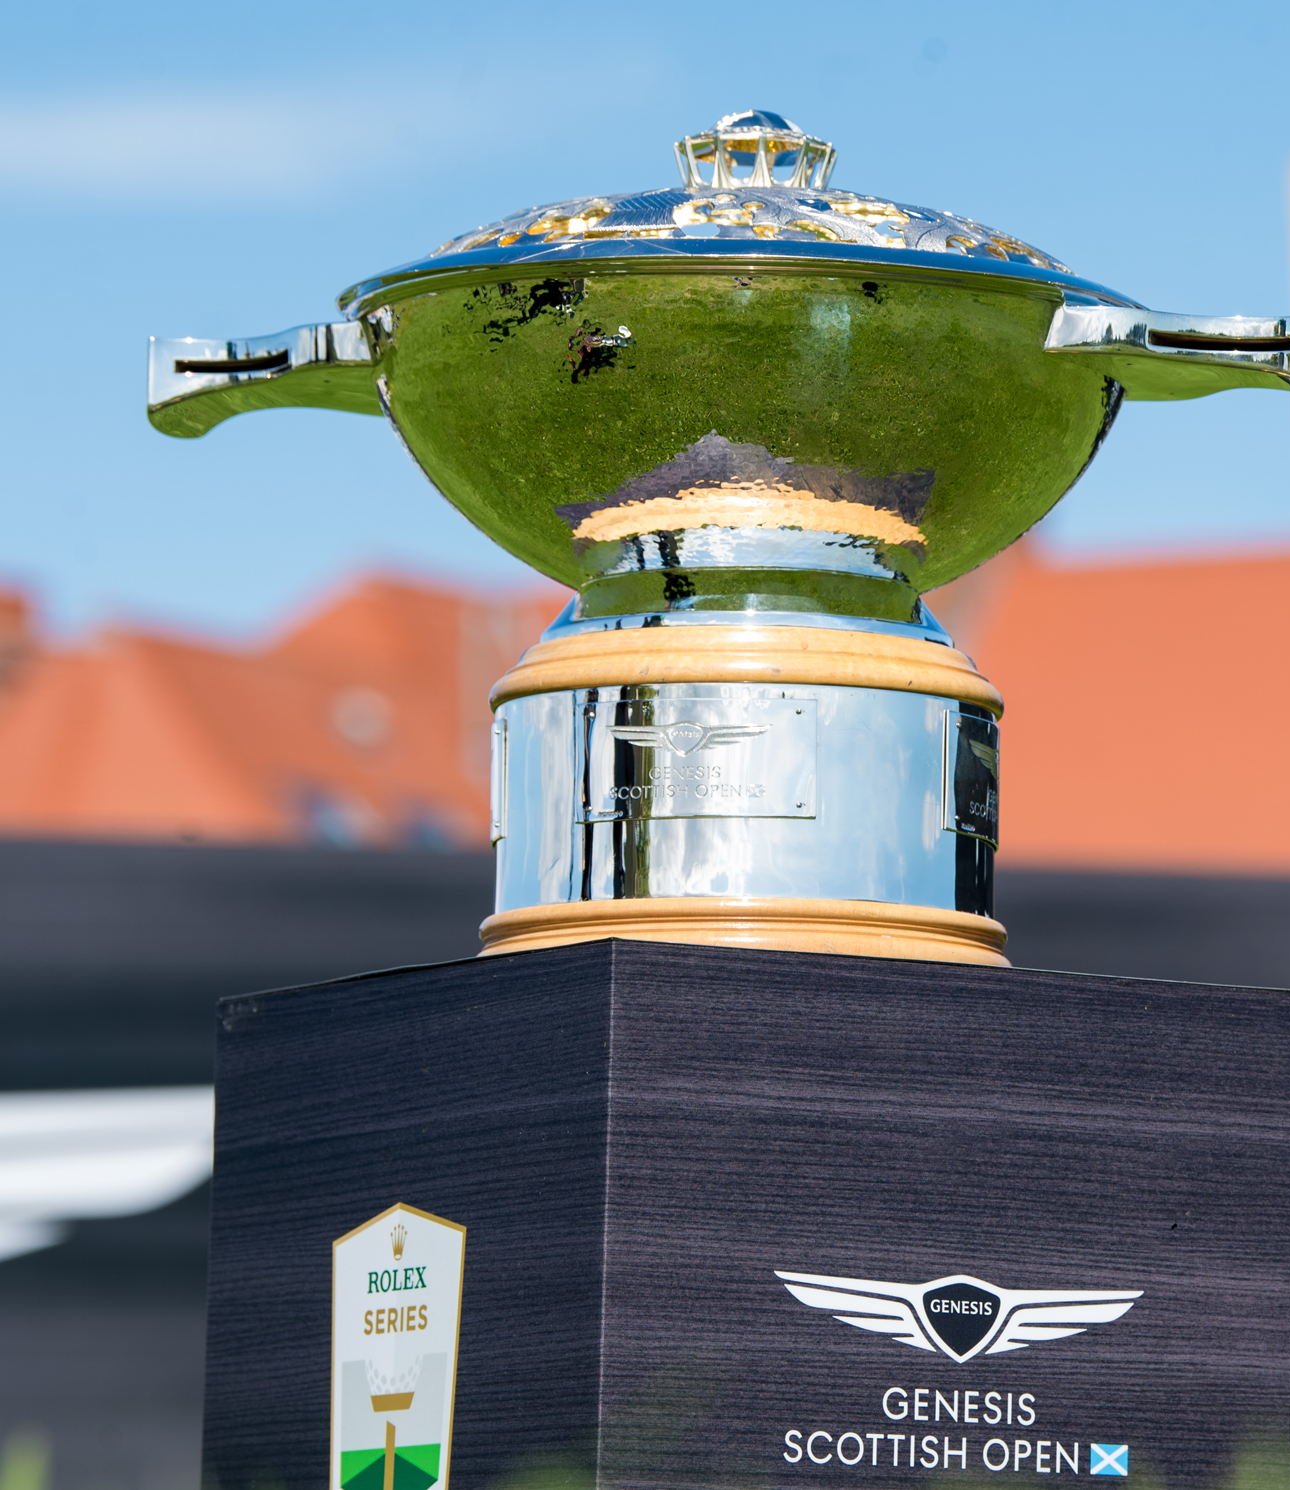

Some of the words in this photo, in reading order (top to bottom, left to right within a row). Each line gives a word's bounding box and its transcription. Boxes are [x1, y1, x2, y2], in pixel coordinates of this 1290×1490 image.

[649, 765, 721, 781] GENESIS
[609, 784, 688, 800] SCOTTISH
[694, 784, 742, 798] OPEN
[367, 1266, 427, 1294] ROLEX
[363, 1304, 428, 1336] SERIES
[929, 1298, 993, 1316] GENESIS
[882, 1386, 1036, 1426] GENESIS
[783, 1429, 967, 1470] SCOTTISH
[982, 1438, 1079, 1474] OPEN
